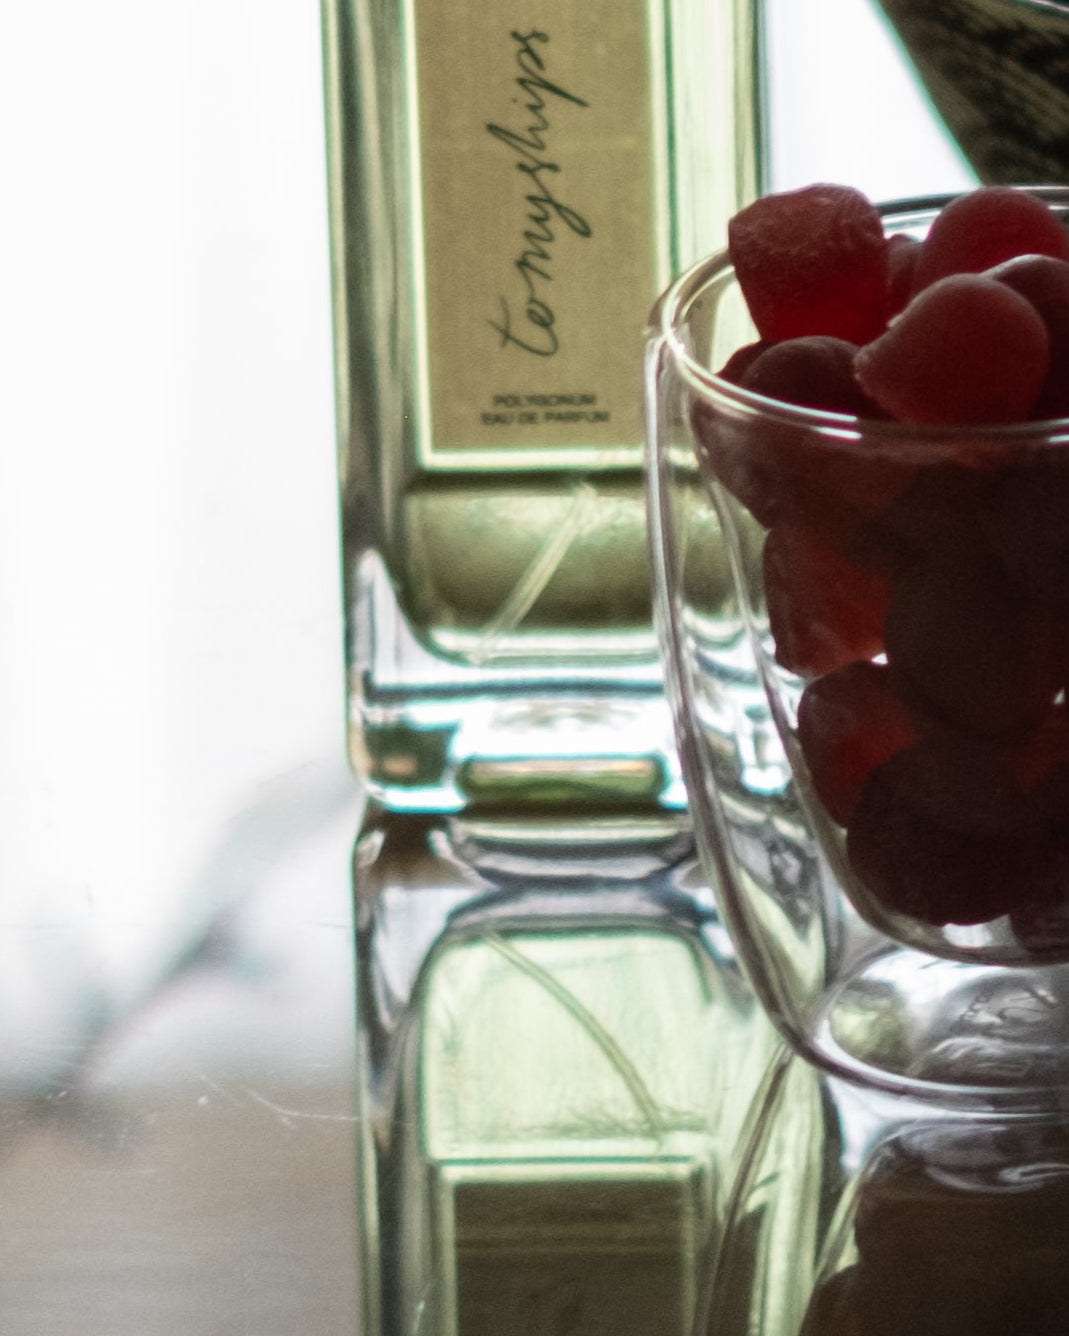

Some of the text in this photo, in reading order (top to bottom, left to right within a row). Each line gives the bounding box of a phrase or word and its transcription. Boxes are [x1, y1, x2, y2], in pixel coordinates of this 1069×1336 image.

[481, 410, 611, 426] EAU DE PARFUM
